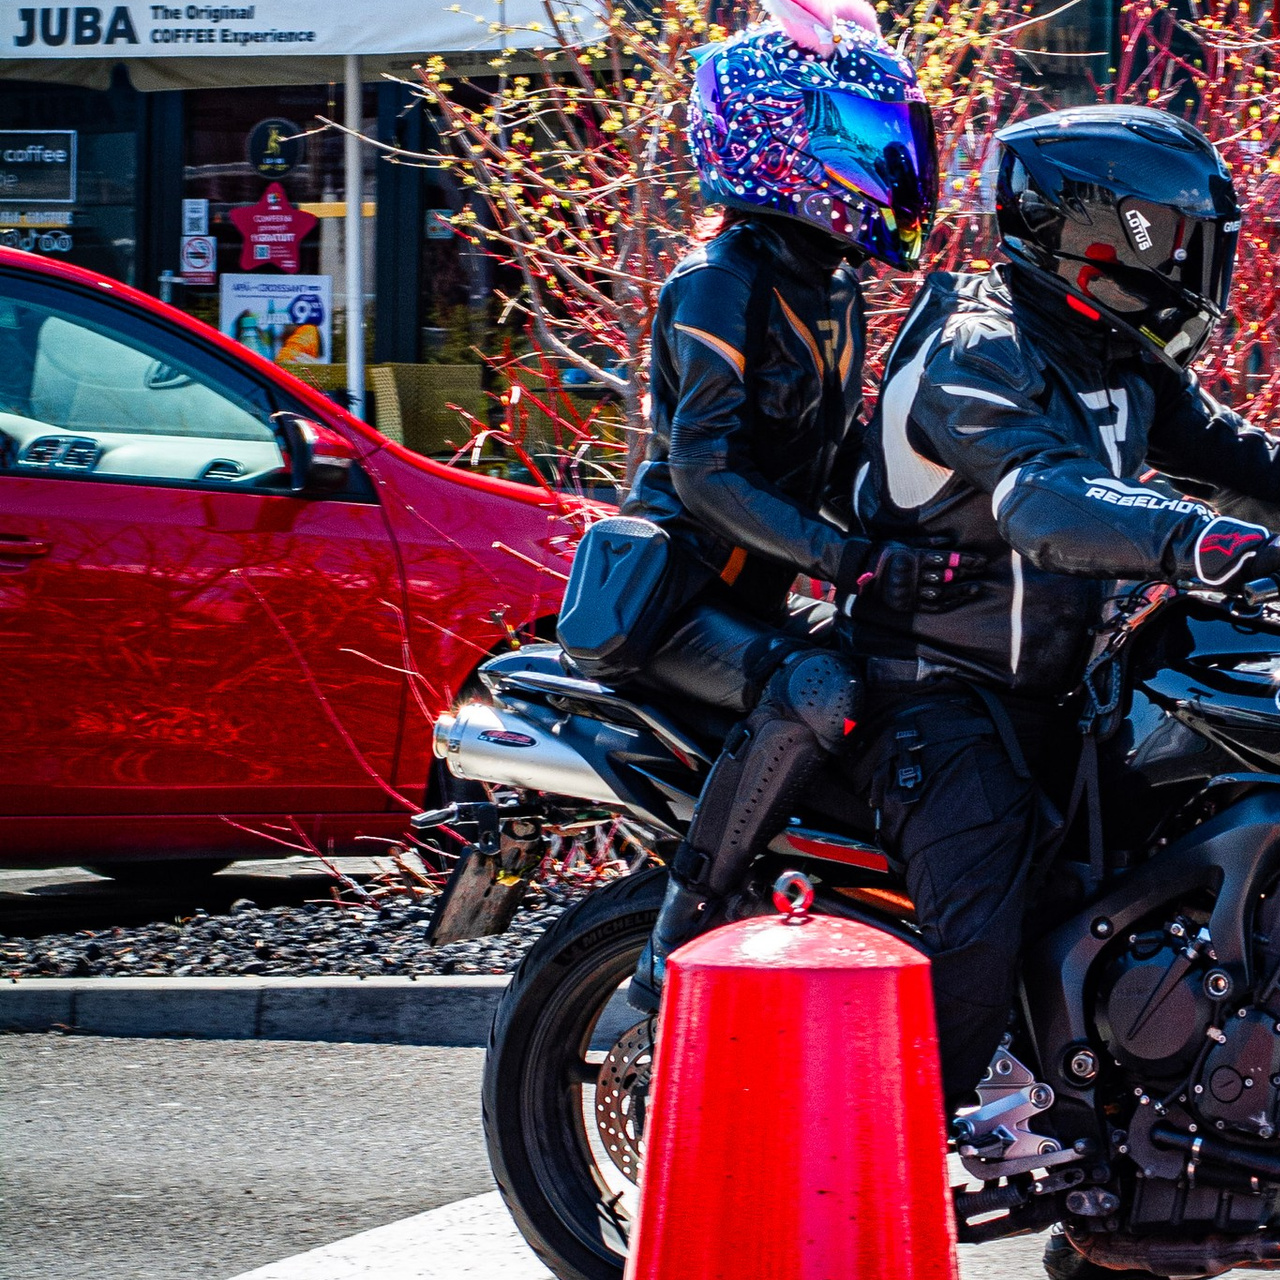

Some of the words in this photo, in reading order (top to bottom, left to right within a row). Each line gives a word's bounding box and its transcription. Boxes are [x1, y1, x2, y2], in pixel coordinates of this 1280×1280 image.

[13, 5, 140, 47] JUBA
[150, 5, 182, 20] The
[185, 5, 256, 23] Original
[150, 28, 216, 44] COFFEE
[221, 28, 317, 46] Experience
[3, 145, 68, 162] coffee
[1125, 209, 1151, 251] LOTUS
